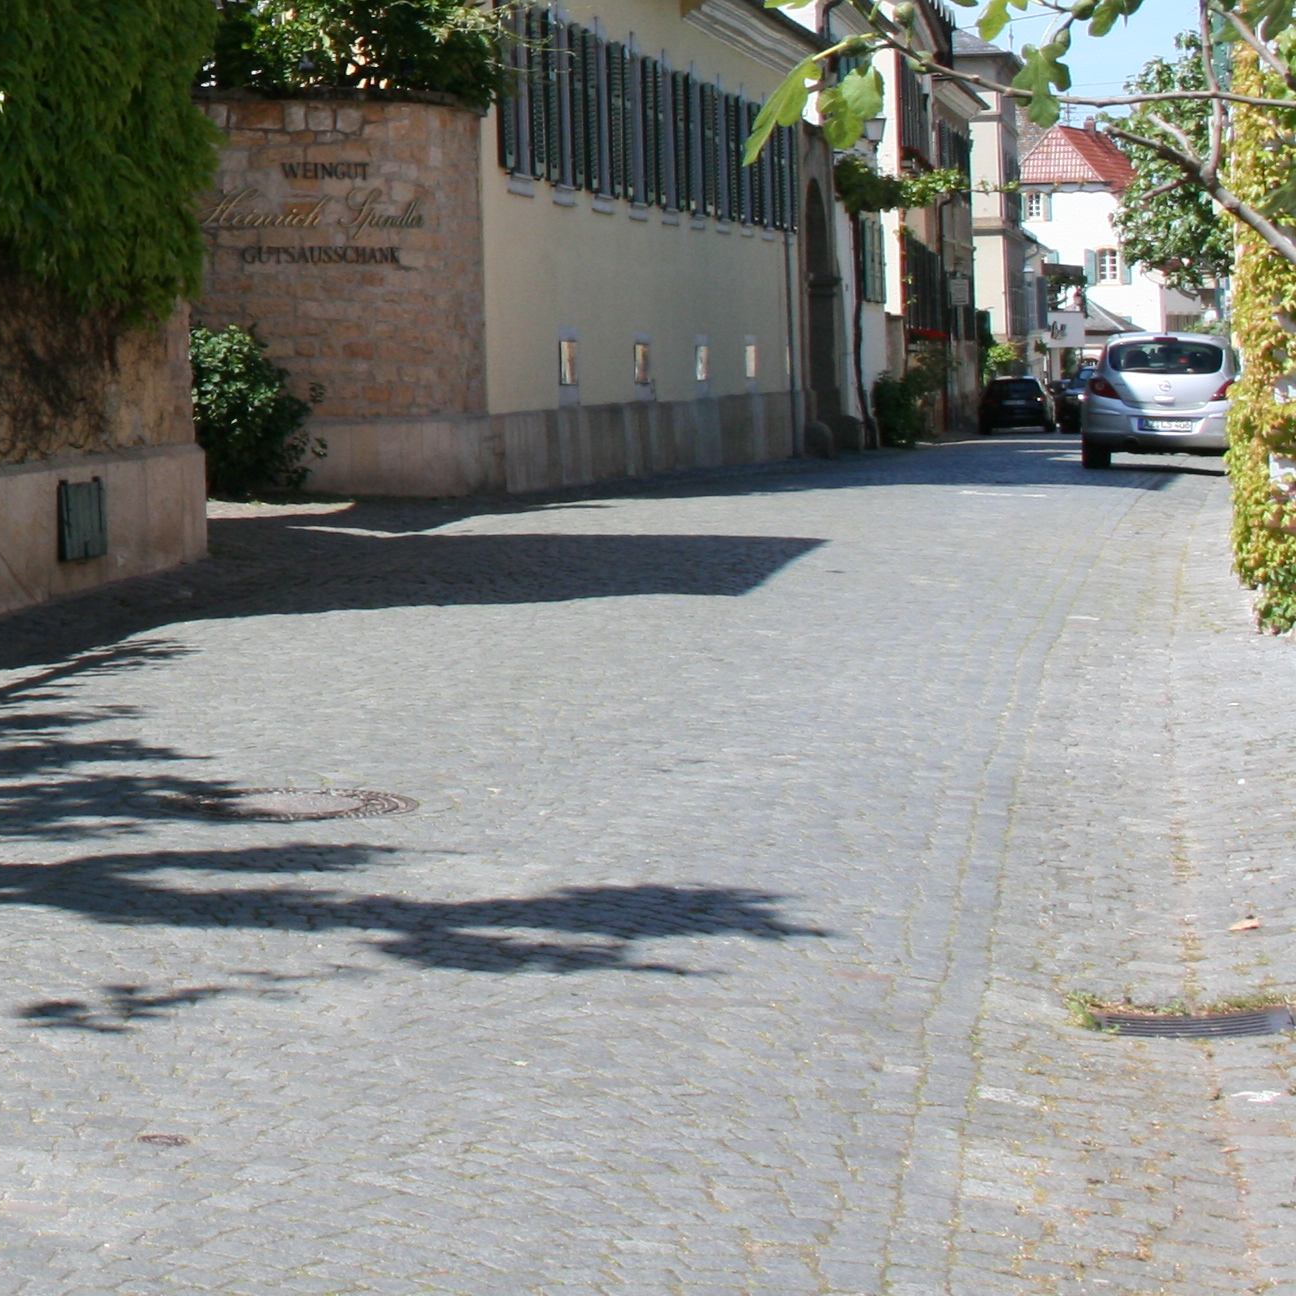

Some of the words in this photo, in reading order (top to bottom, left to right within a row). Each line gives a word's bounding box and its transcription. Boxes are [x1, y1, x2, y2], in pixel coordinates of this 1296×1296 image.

[281, 161, 370, 181] WEINGUT
[201, 186, 330, 228] Heinrich
[340, 186, 425, 240] Spindler
[242, 246, 401, 265] GUTSAUSSCHANK
